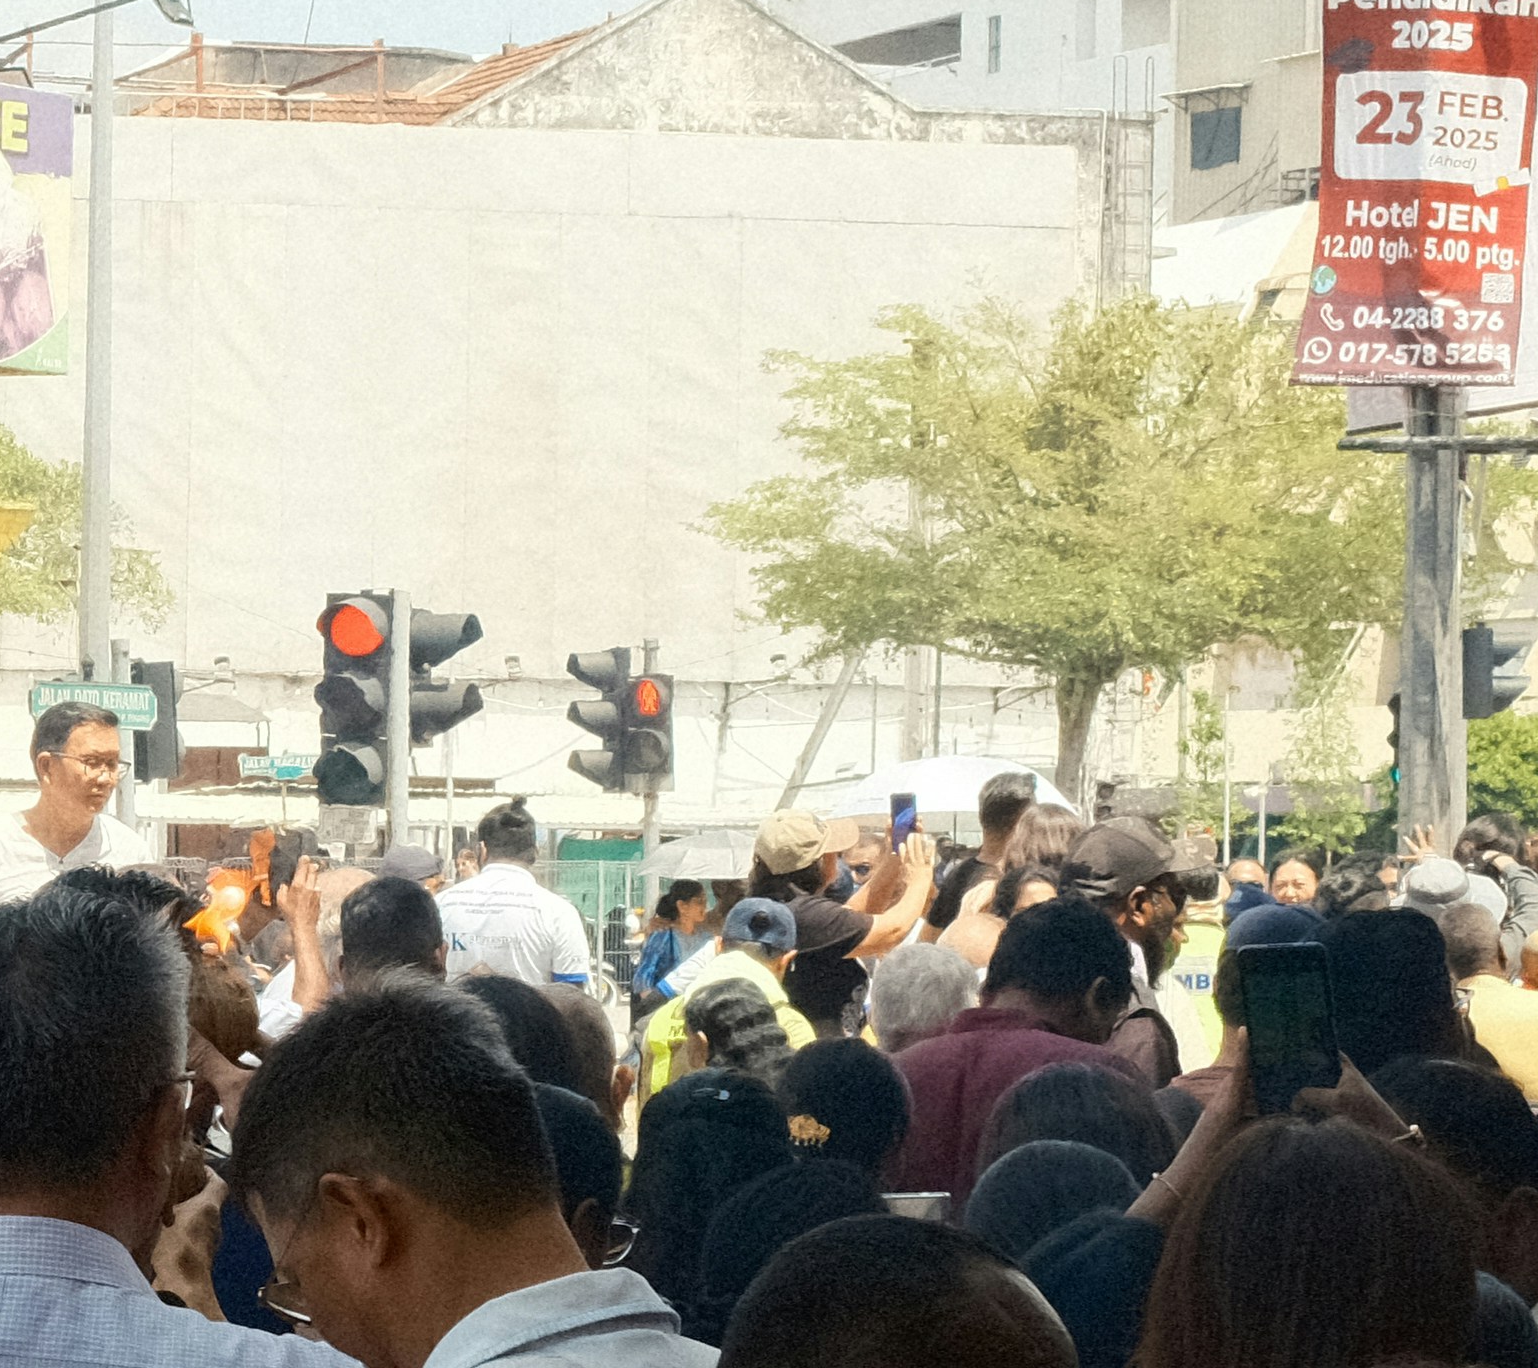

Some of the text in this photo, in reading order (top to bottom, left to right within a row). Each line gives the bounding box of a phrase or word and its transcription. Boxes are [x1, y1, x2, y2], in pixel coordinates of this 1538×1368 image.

[1391, 20, 1474, 53] 2025
[1355, 89, 1425, 145] 23
[1438, 91, 1509, 122] FEB.
[1432, 126, 1499, 152] 2025
[1428, 153, 1478, 172] (Ahad)
[1346, 199, 1500, 234] Hotel JEN
[1321, 235, 1374, 259] 12.00
[1423, 237, 1470, 263] 5.00
[1475, 243, 1520, 271] ptg.
[1353, 305, 1505, 332] 04-2288 376
[1338, 341, 1437, 366] 017-578
[38, 687, 70, 706] JALAN
[103, 691, 150, 711] KERAMAT
